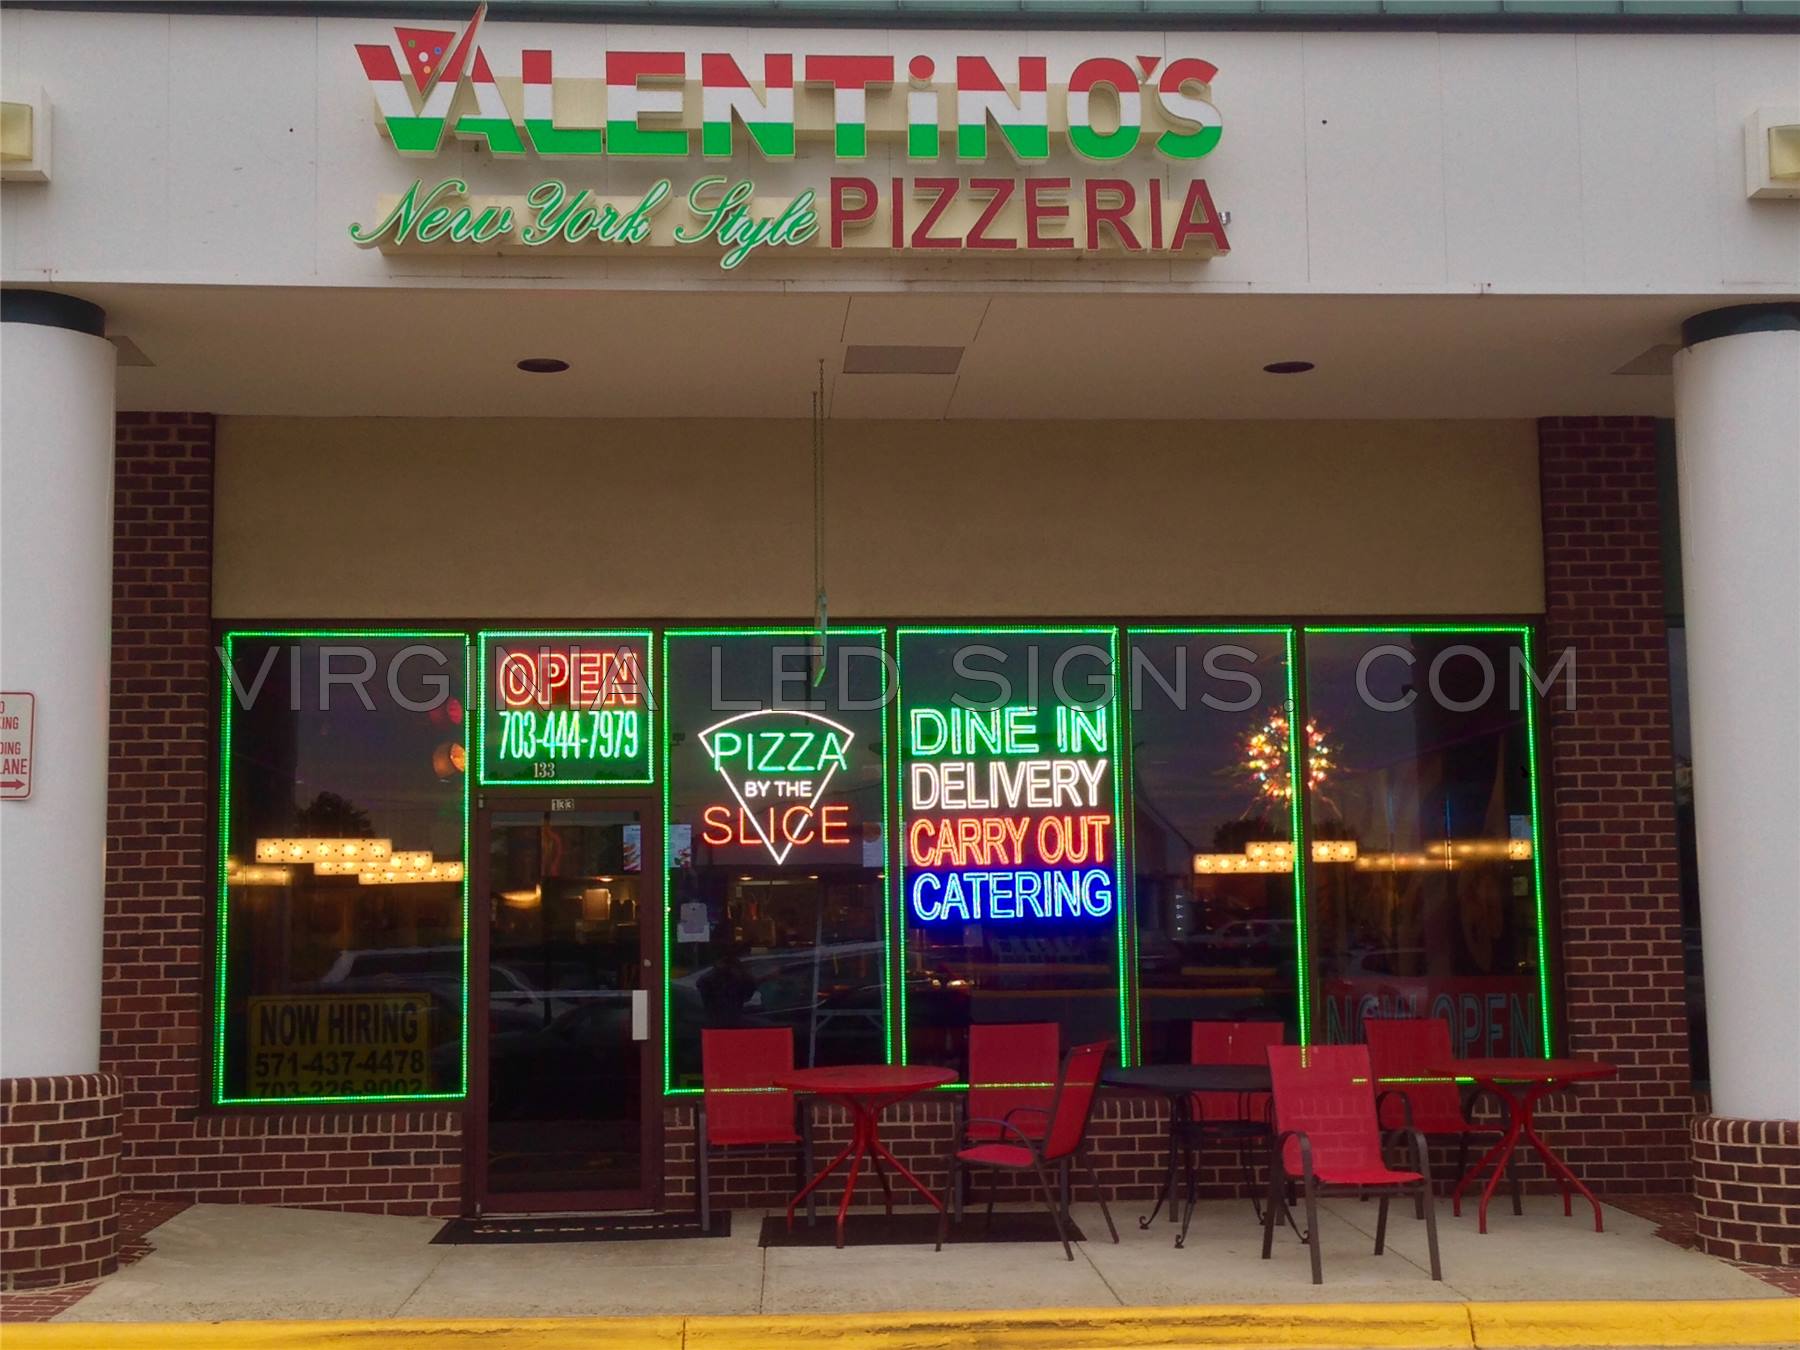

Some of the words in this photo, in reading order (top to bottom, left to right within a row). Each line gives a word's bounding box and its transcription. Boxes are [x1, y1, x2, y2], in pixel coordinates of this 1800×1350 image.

[349, 178, 513, 245] New
[522, 179, 671, 244] York
[673, 175, 820, 269] Style
[830, 177, 1231, 250] PIZZERIA
[500, 652, 638, 706] OPEN
[499, 710, 638, 760] 703-444-7979
[714, 732, 848, 772] PIZZA
[910, 706, 1039, 755] DINE
[1056, 705, 1108, 753] IN
[533, 761, 556, 778] 133
[745, 781, 771, 798] BY
[774, 781, 813, 798] THE
[911, 759, 1108, 810] DELIVERY
[703, 805, 850, 845] SLICE
[910, 818, 1031, 866] CARRY
[1038, 815, 1111, 864] OUT
[913, 869, 1112, 920] CATERING
[260, 1004, 320, 1046] NOW
[328, 1002, 418, 1044] HIRING
[255, 1050, 425, 1078] 571-437-4478
